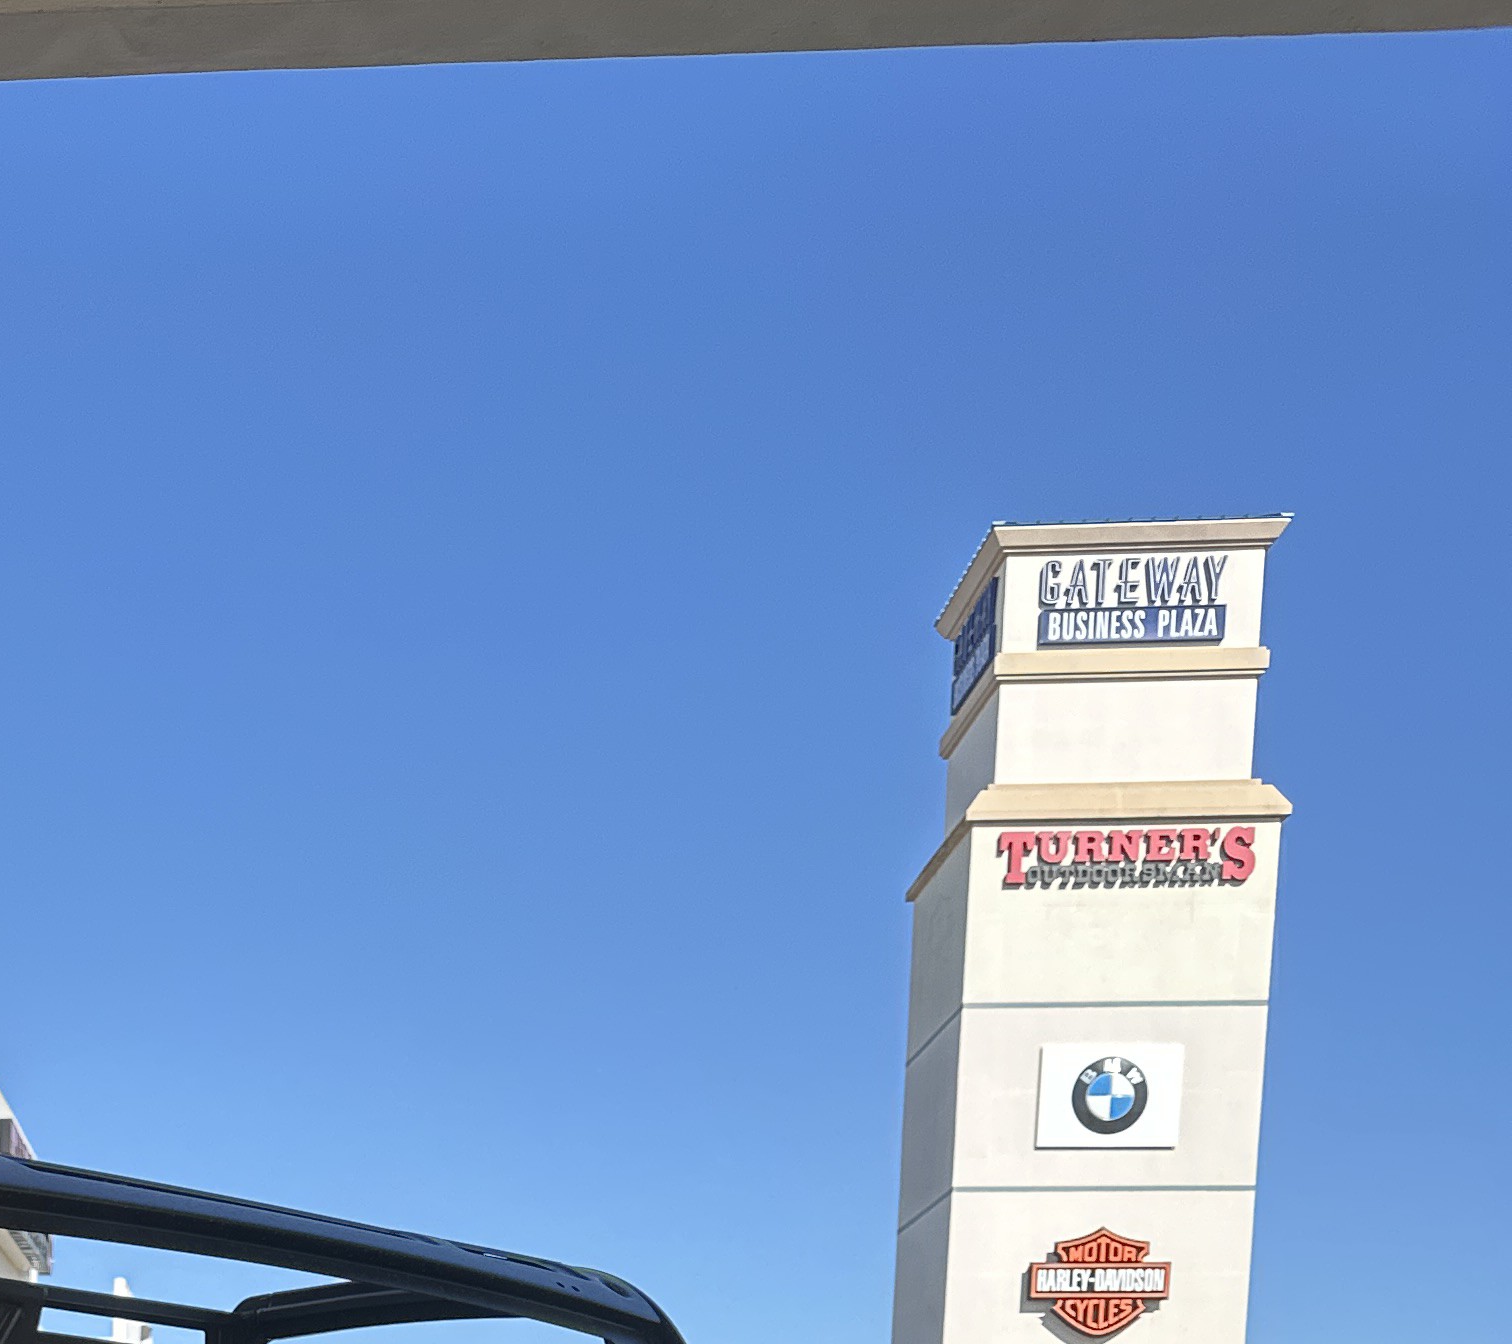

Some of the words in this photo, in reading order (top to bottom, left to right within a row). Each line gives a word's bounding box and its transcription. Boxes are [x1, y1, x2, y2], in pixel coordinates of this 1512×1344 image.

[1039, 555, 1228, 607] GATEWAY
[1047, 610, 1146, 641] BUSINESS
[1157, 608, 1219, 638] PLAZA
[998, 826, 1256, 886] TURNER'S
[1025, 862, 1222, 886] OUTDOORSMAN
[1078, 1056, 1144, 1085] BMW
[1068, 1238, 1139, 1263] MOTOR
[1036, 1267, 1166, 1293] HARLEY-DAVIDSON
[1064, 1298, 1133, 1330] CYCLES
